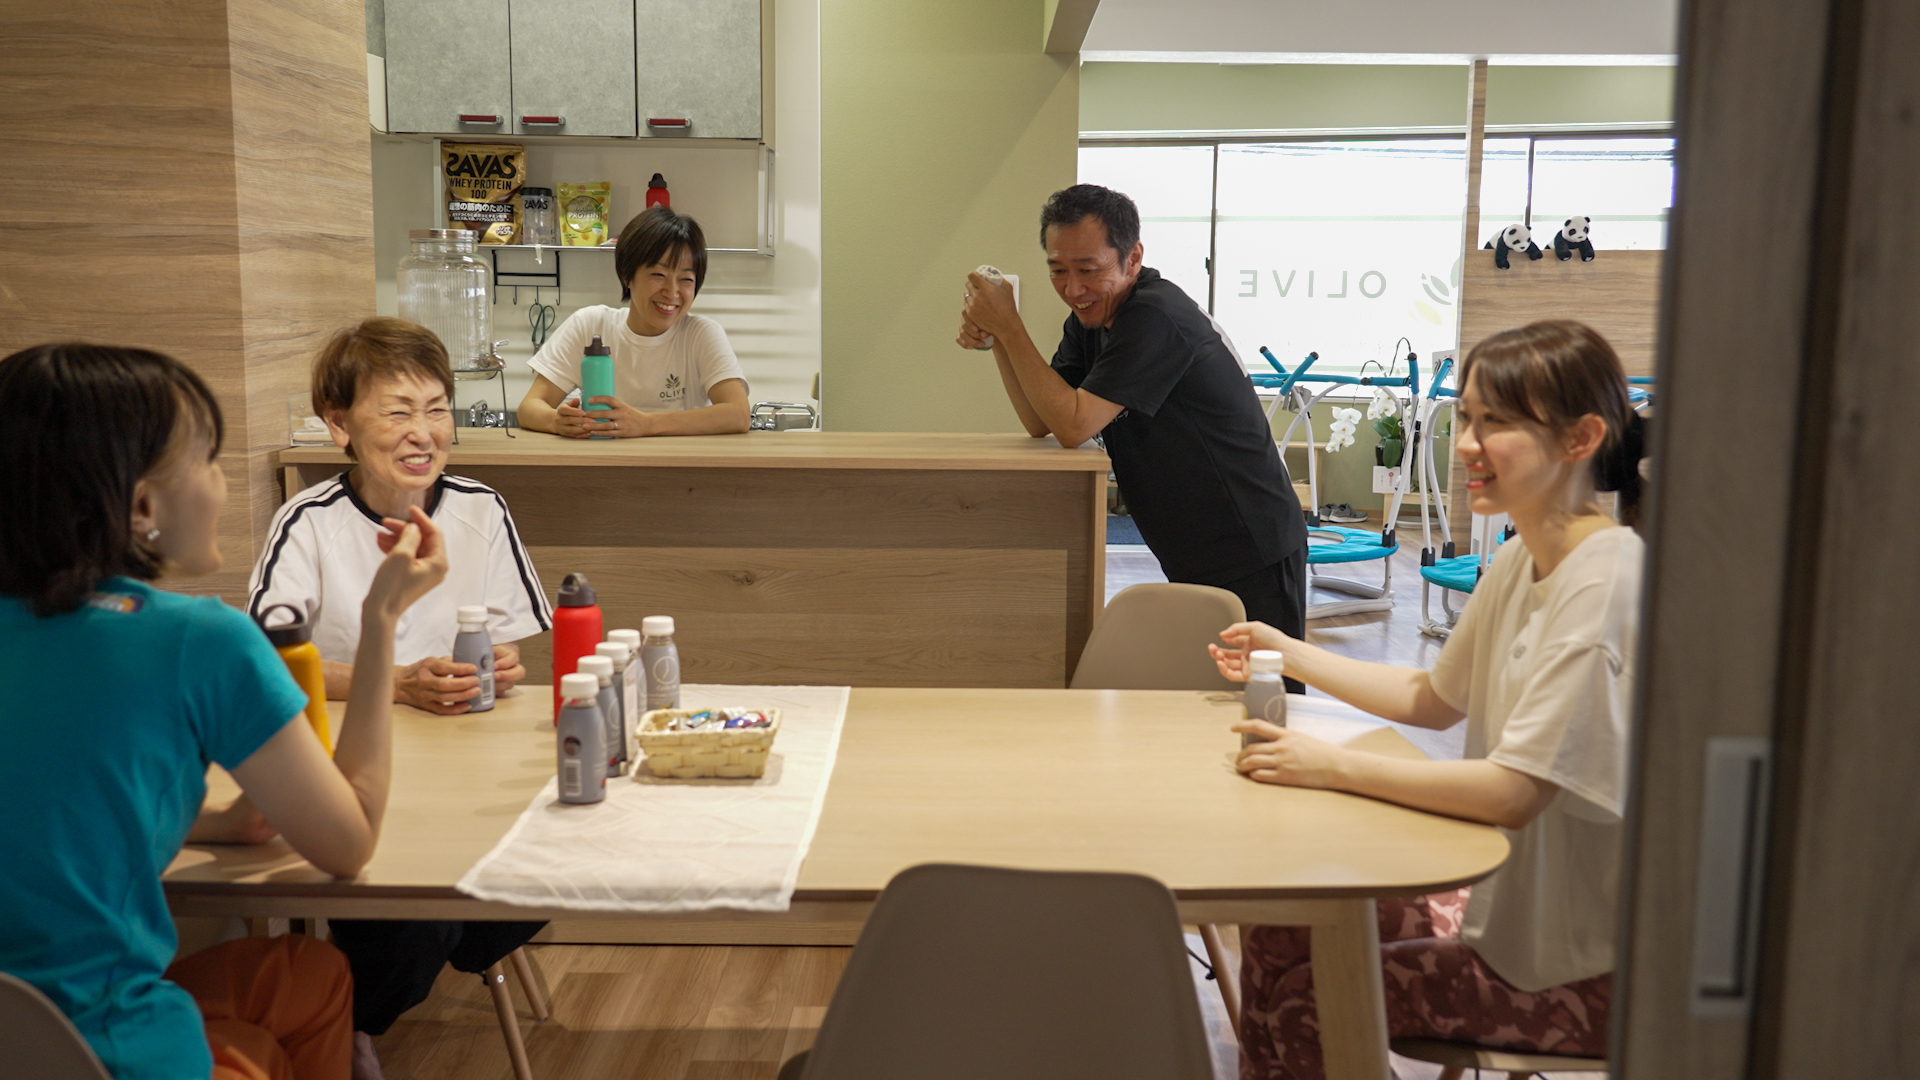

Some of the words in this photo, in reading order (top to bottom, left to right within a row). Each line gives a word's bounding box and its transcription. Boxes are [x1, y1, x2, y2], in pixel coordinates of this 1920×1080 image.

[446, 153, 516, 179] SAVAS
[449, 178, 472, 188] WHEY
[474, 180, 512, 190] PROTEIN
[471, 190, 487, 199] 100
[525, 200, 548, 210] SAVAS
